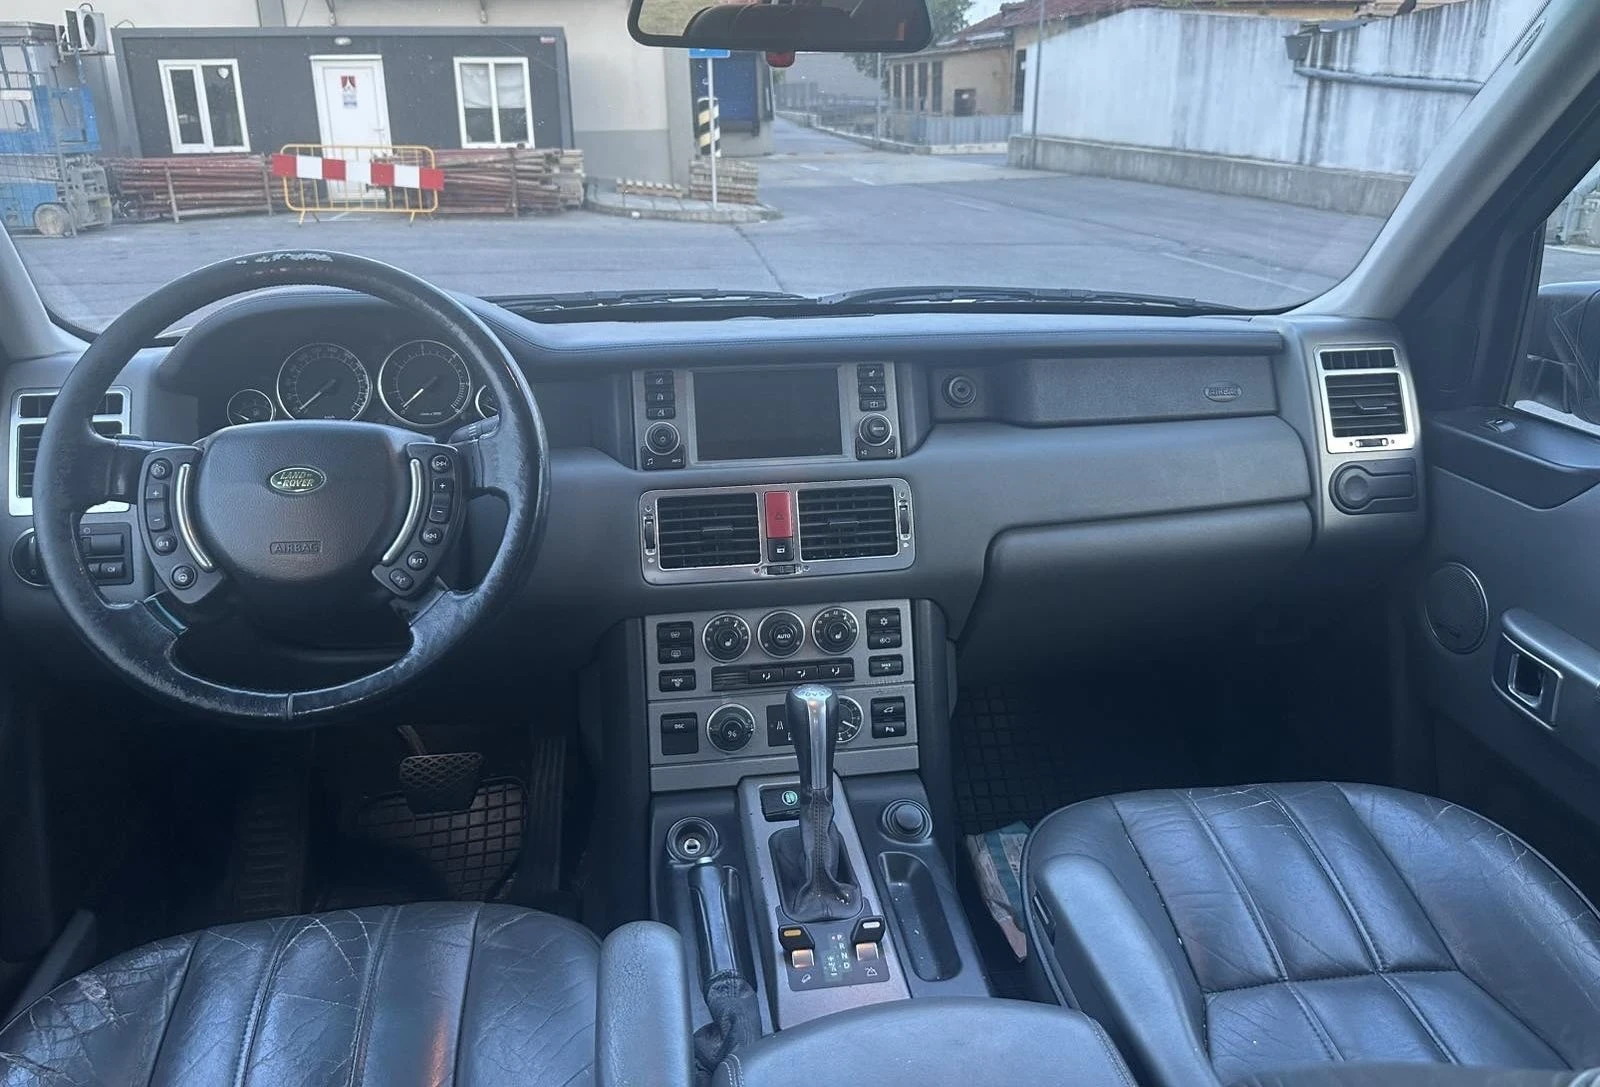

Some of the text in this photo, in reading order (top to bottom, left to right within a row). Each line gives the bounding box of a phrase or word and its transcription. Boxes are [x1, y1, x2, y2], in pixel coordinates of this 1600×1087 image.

[279, 471, 306, 480] LAND
[282, 479, 313, 487] ROVER
[274, 542, 320, 553] AIRBAG
[843, 961, 850, 969] D
